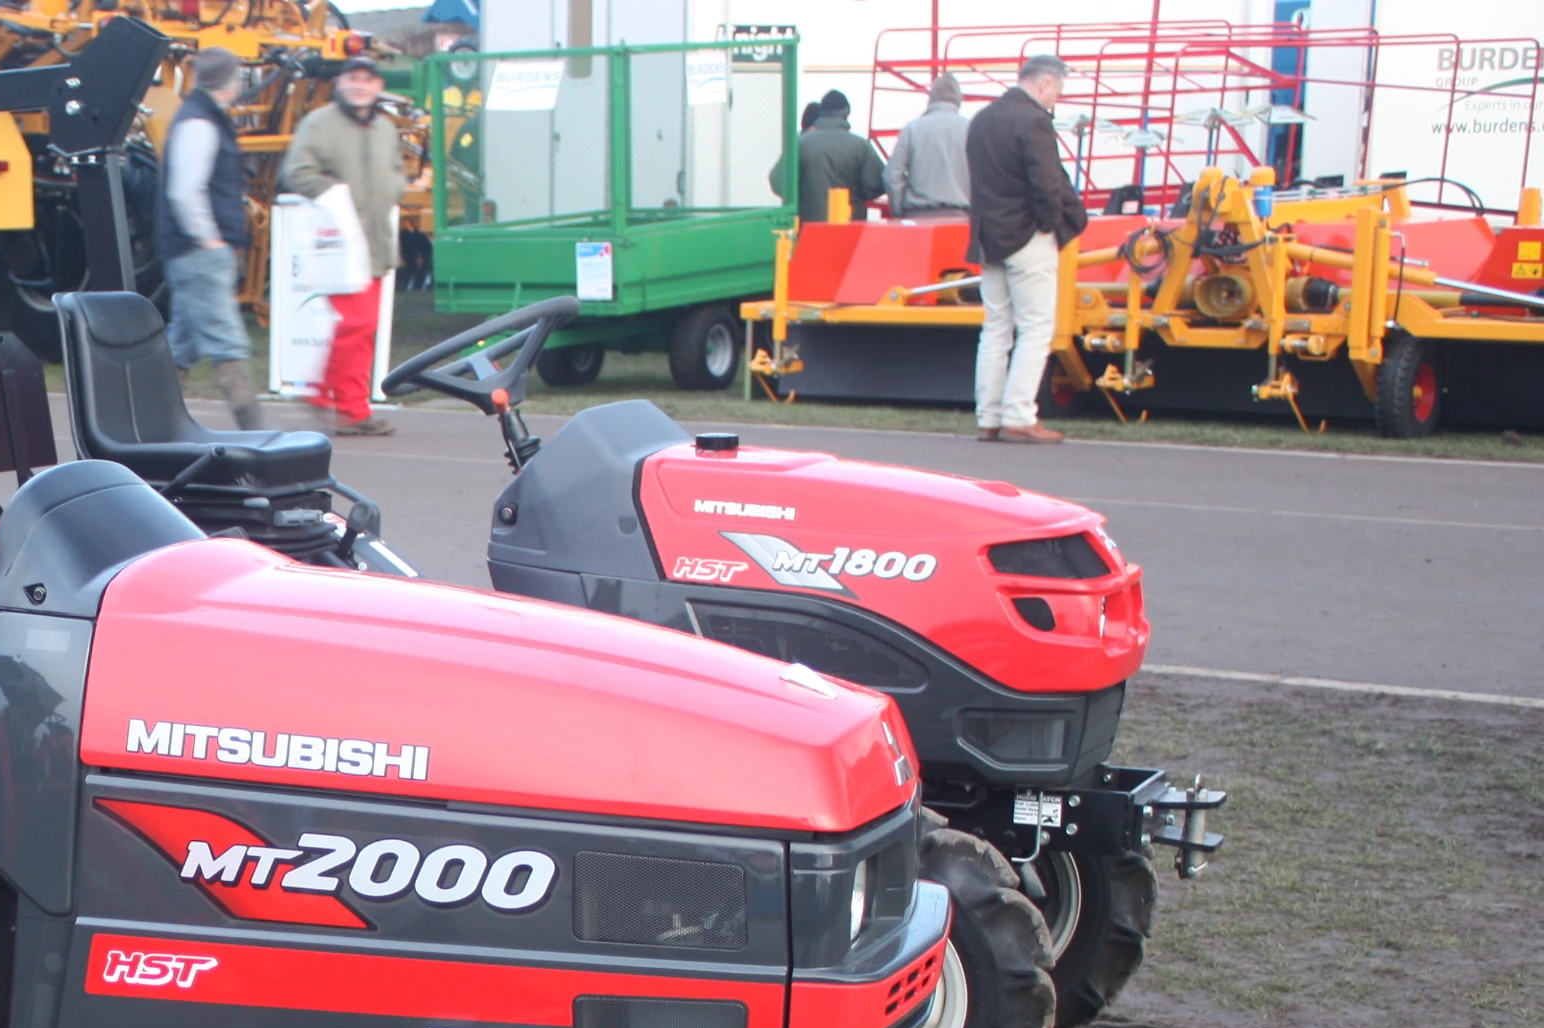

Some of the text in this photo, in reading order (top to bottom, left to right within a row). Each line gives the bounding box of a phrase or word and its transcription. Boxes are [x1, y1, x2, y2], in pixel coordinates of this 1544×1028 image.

[1437, 47, 1544, 71] BURDE
[1464, 101, 1507, 113] Experts
[1510, 101, 1522, 111] in
[694, 499, 795, 521] MITSUBISHI
[673, 547, 937, 582] HST MT1800
[126, 718, 431, 781] MITSUBISHI
[180, 832, 558, 912] MT2000
[102, 950, 219, 989] HST
